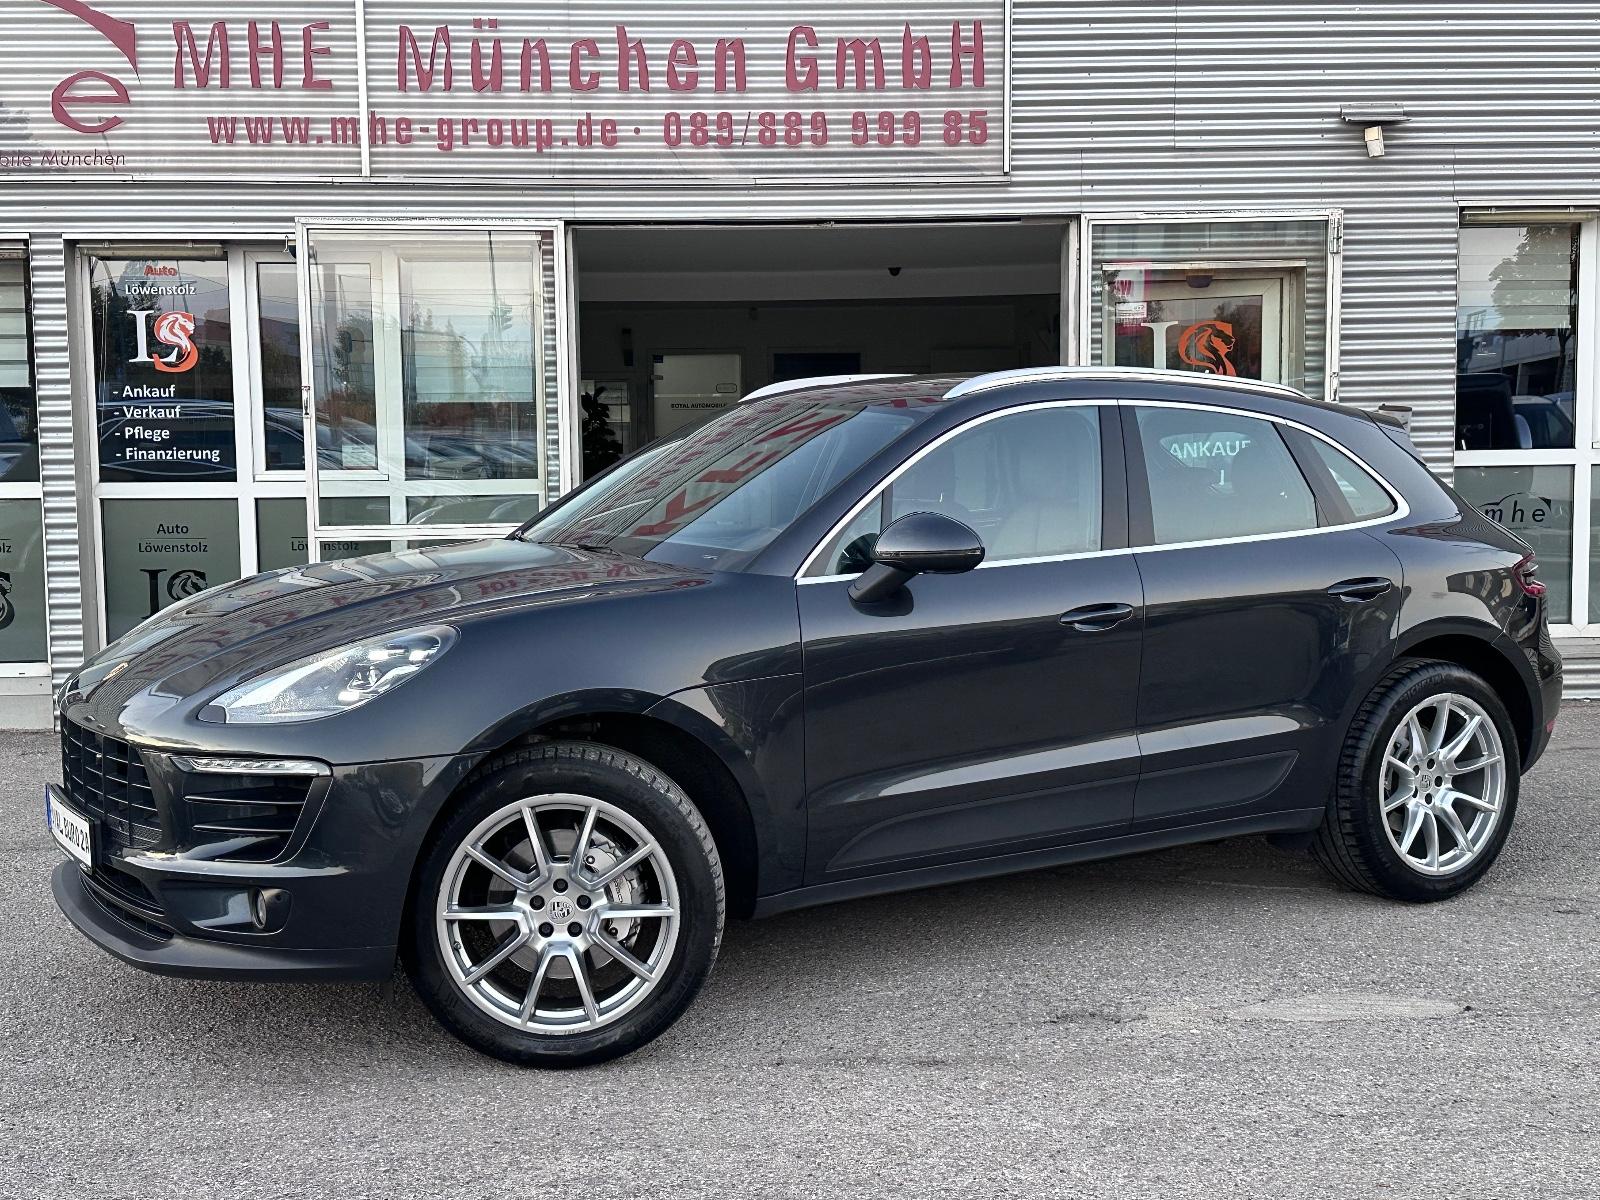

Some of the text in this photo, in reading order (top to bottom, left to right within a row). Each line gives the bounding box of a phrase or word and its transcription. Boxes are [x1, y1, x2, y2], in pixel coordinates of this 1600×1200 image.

[175, 19, 984, 92] MHE München GmbH
[209, 110, 988, 151] www.mhe-group.de 089/889 999 85
[40, 149, 126, 166] München
[144, 265, 178, 277] Auto
[124, 282, 196, 296] Löwenstolz
[122, 384, 176, 398] Ankauf
[123, 404, 181, 419] Verkauf
[124, 425, 170, 442] Pflege
[125, 446, 221, 462] Finanzierung
[156, 523, 190, 535] Auto
[138, 538, 208, 553] Löwenstolz
